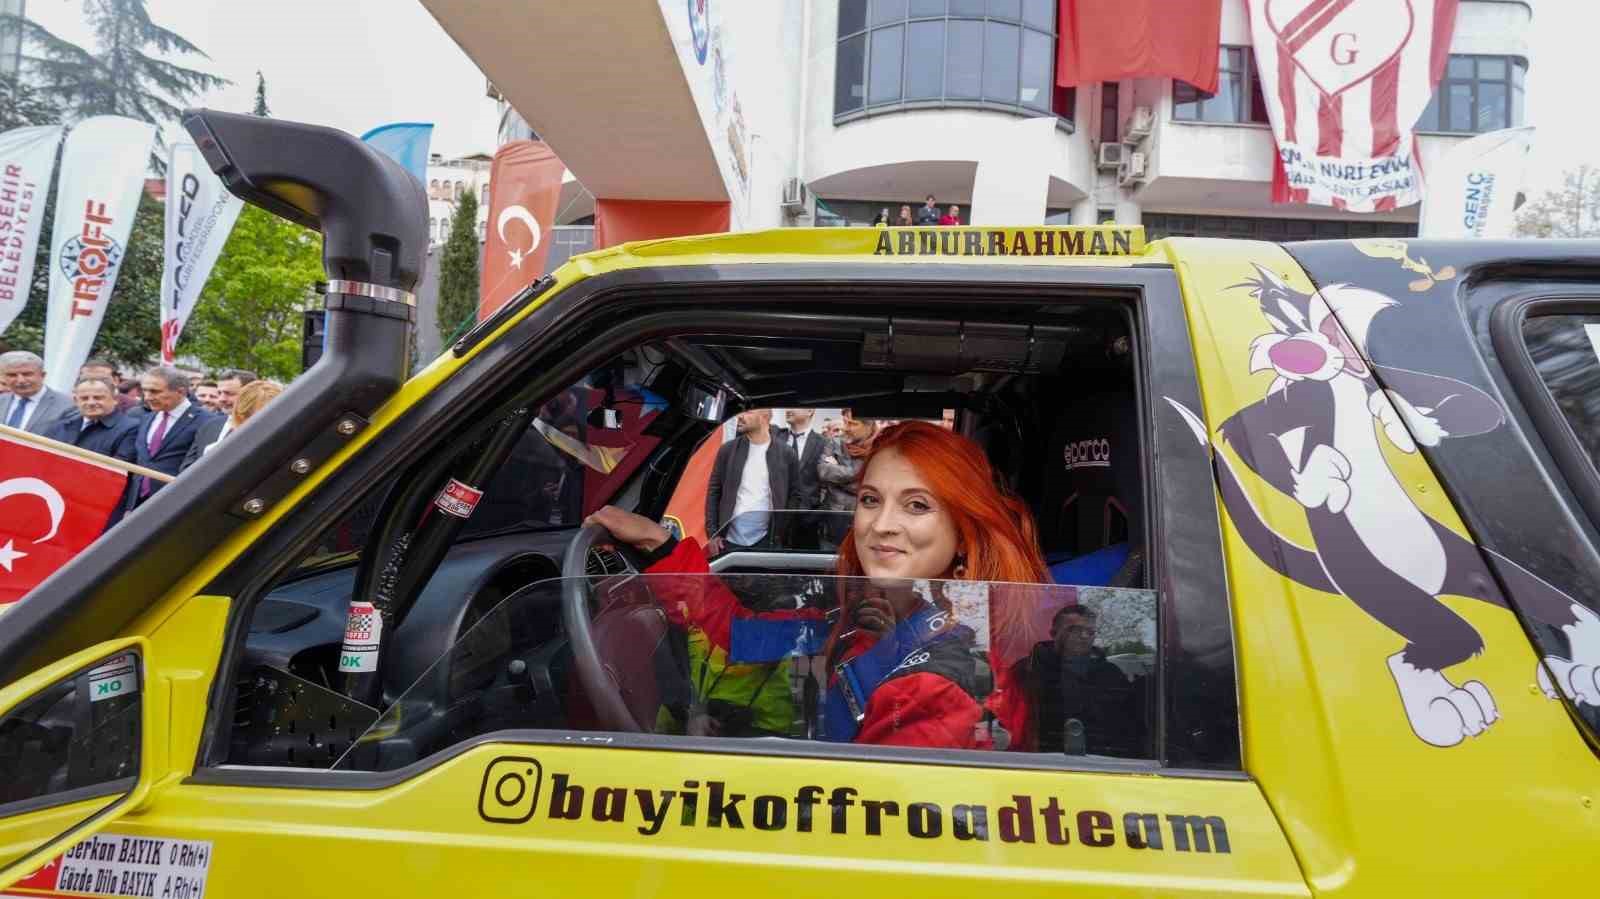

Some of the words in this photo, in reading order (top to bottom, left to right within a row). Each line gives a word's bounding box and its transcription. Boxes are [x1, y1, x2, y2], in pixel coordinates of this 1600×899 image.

[1330, 32, 1359, 66] G
[874, 230, 1132, 256] ABDURRAHMAN
[70, 199, 113, 320] TROFF
[342, 655, 360, 668] OK
[548, 771, 1231, 854] bayikoffroadteam
[118, 838, 164, 866] BAYIK
[59, 866, 93, 892] Gözde
[119, 871, 158, 897] BAYIK
[162, 876, 172, 897] A
